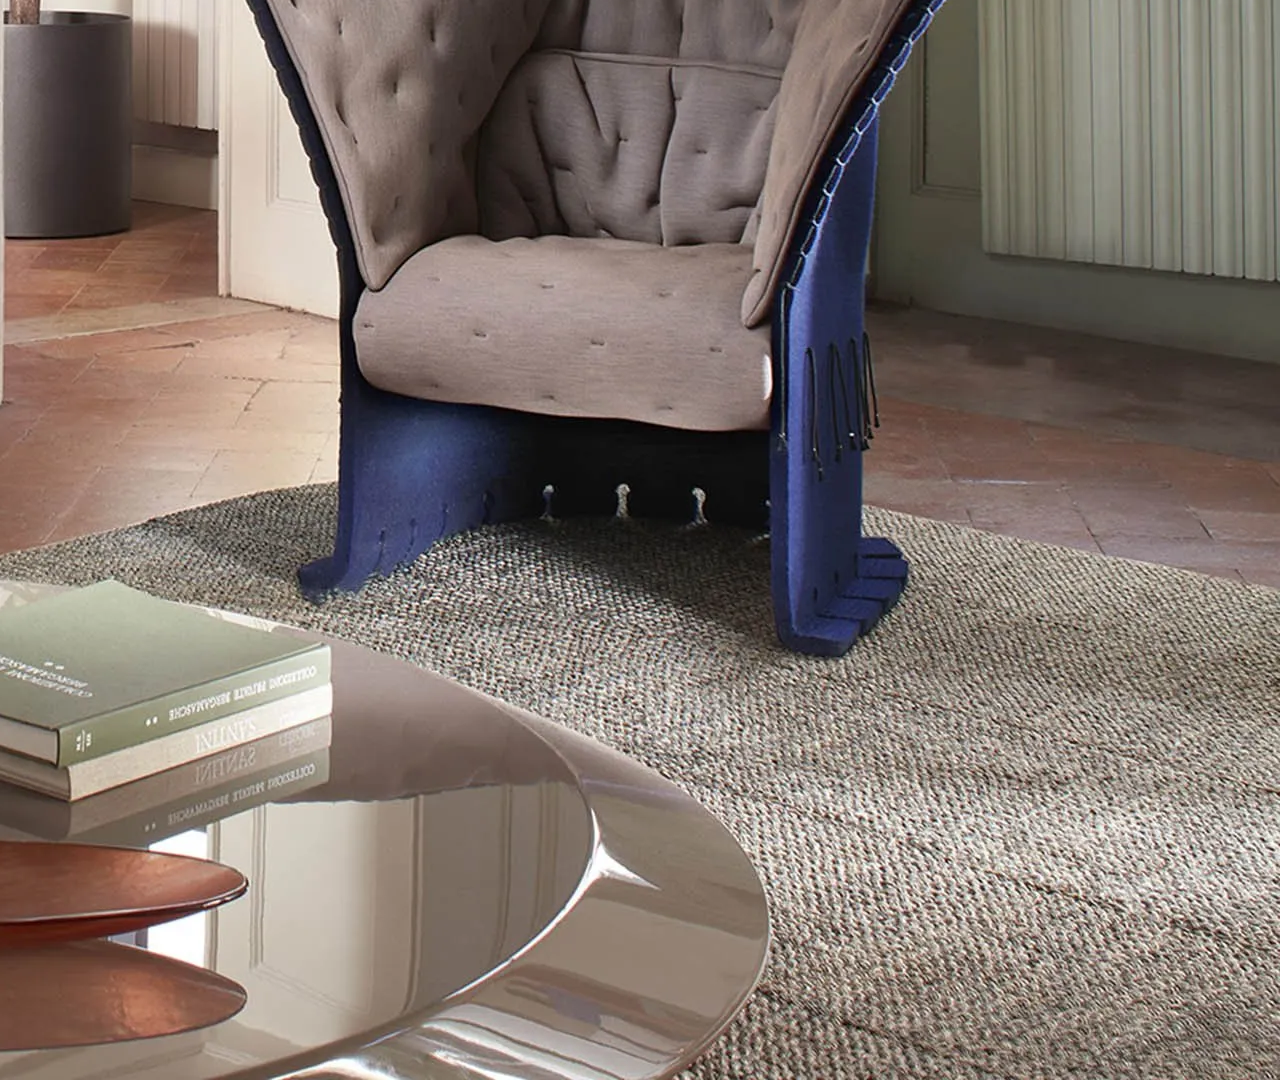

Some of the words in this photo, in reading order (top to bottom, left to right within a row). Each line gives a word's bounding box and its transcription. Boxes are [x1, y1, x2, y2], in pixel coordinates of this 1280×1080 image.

[232, 679, 268, 701] PRIVATE
[269, 666, 318, 691] COLLEZIONI
[169, 690, 232, 722] BERGAMASCHE
[194, 715, 258, 754] SANTINI
